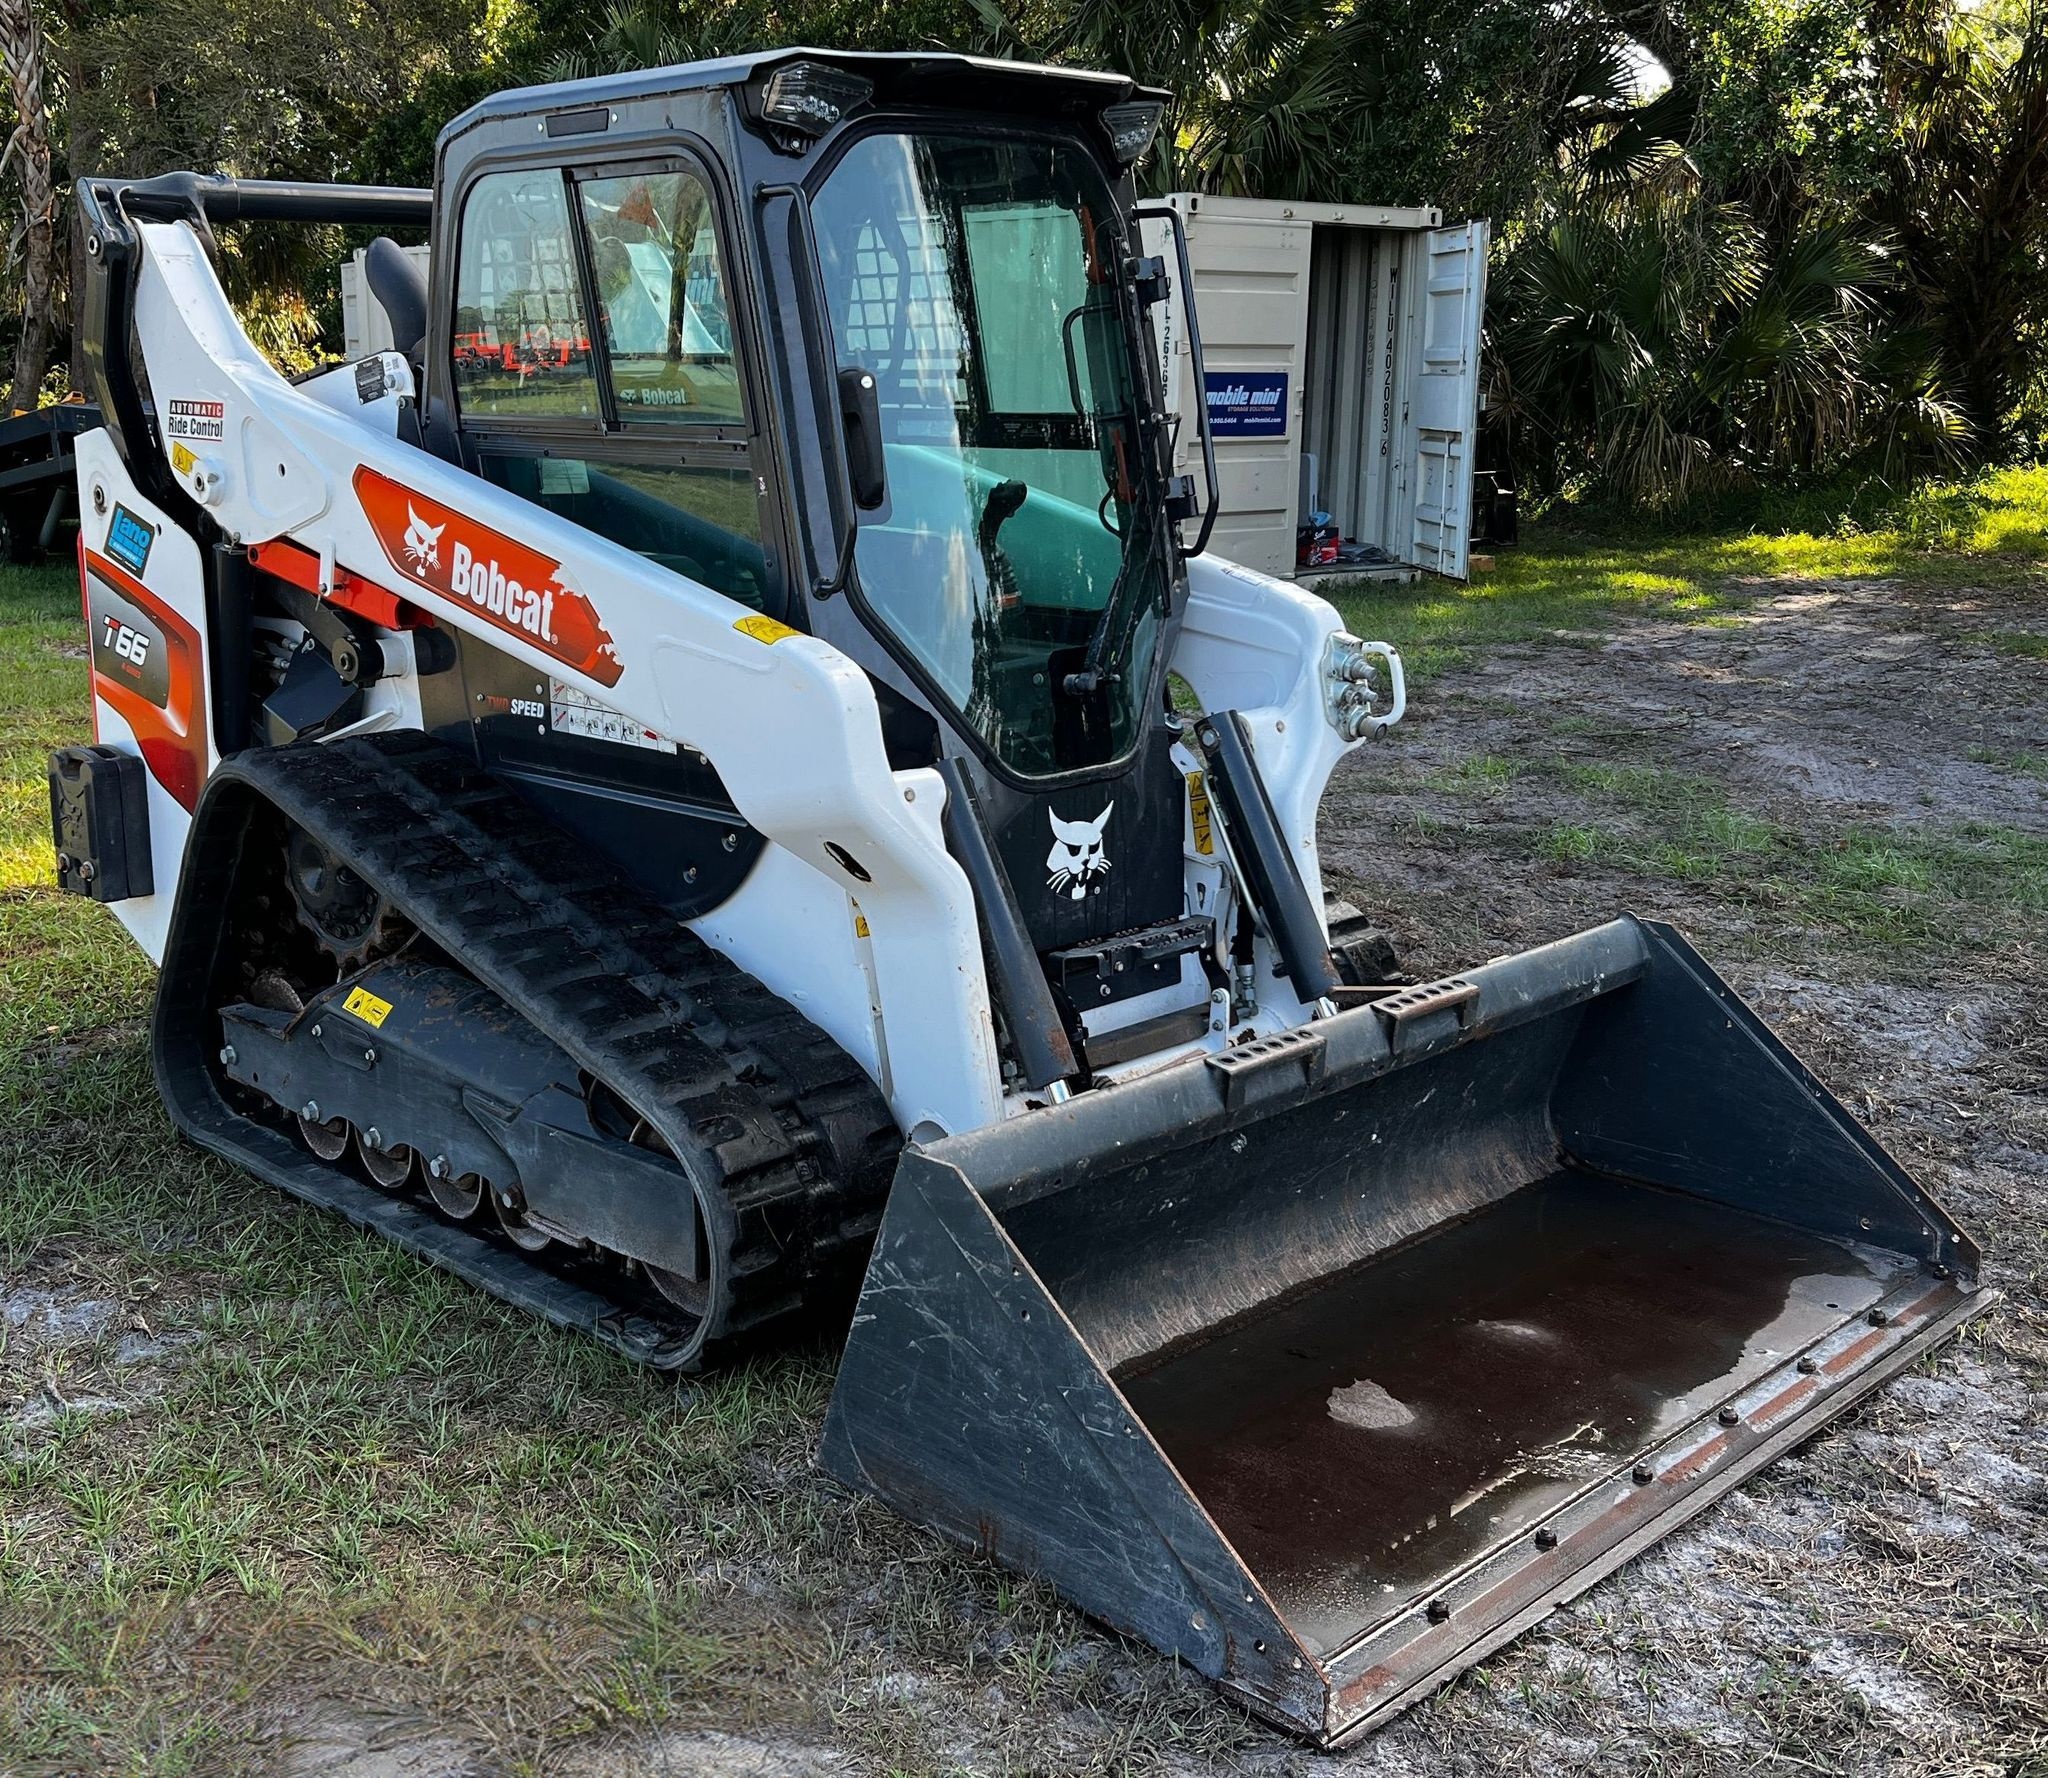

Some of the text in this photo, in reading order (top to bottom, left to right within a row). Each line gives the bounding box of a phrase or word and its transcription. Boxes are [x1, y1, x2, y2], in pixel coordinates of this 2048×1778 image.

[641, 388, 688, 405] Bobcat
[1206, 385, 1282, 405] mobile mini
[170, 401, 223, 417] AUTOMATIC
[168, 416, 223, 437] Ride Control
[111, 508, 151, 550] Lano
[451, 541, 554, 642] Bobcat
[103, 615, 150, 666] T66
[511, 698, 545, 718] SPEED
